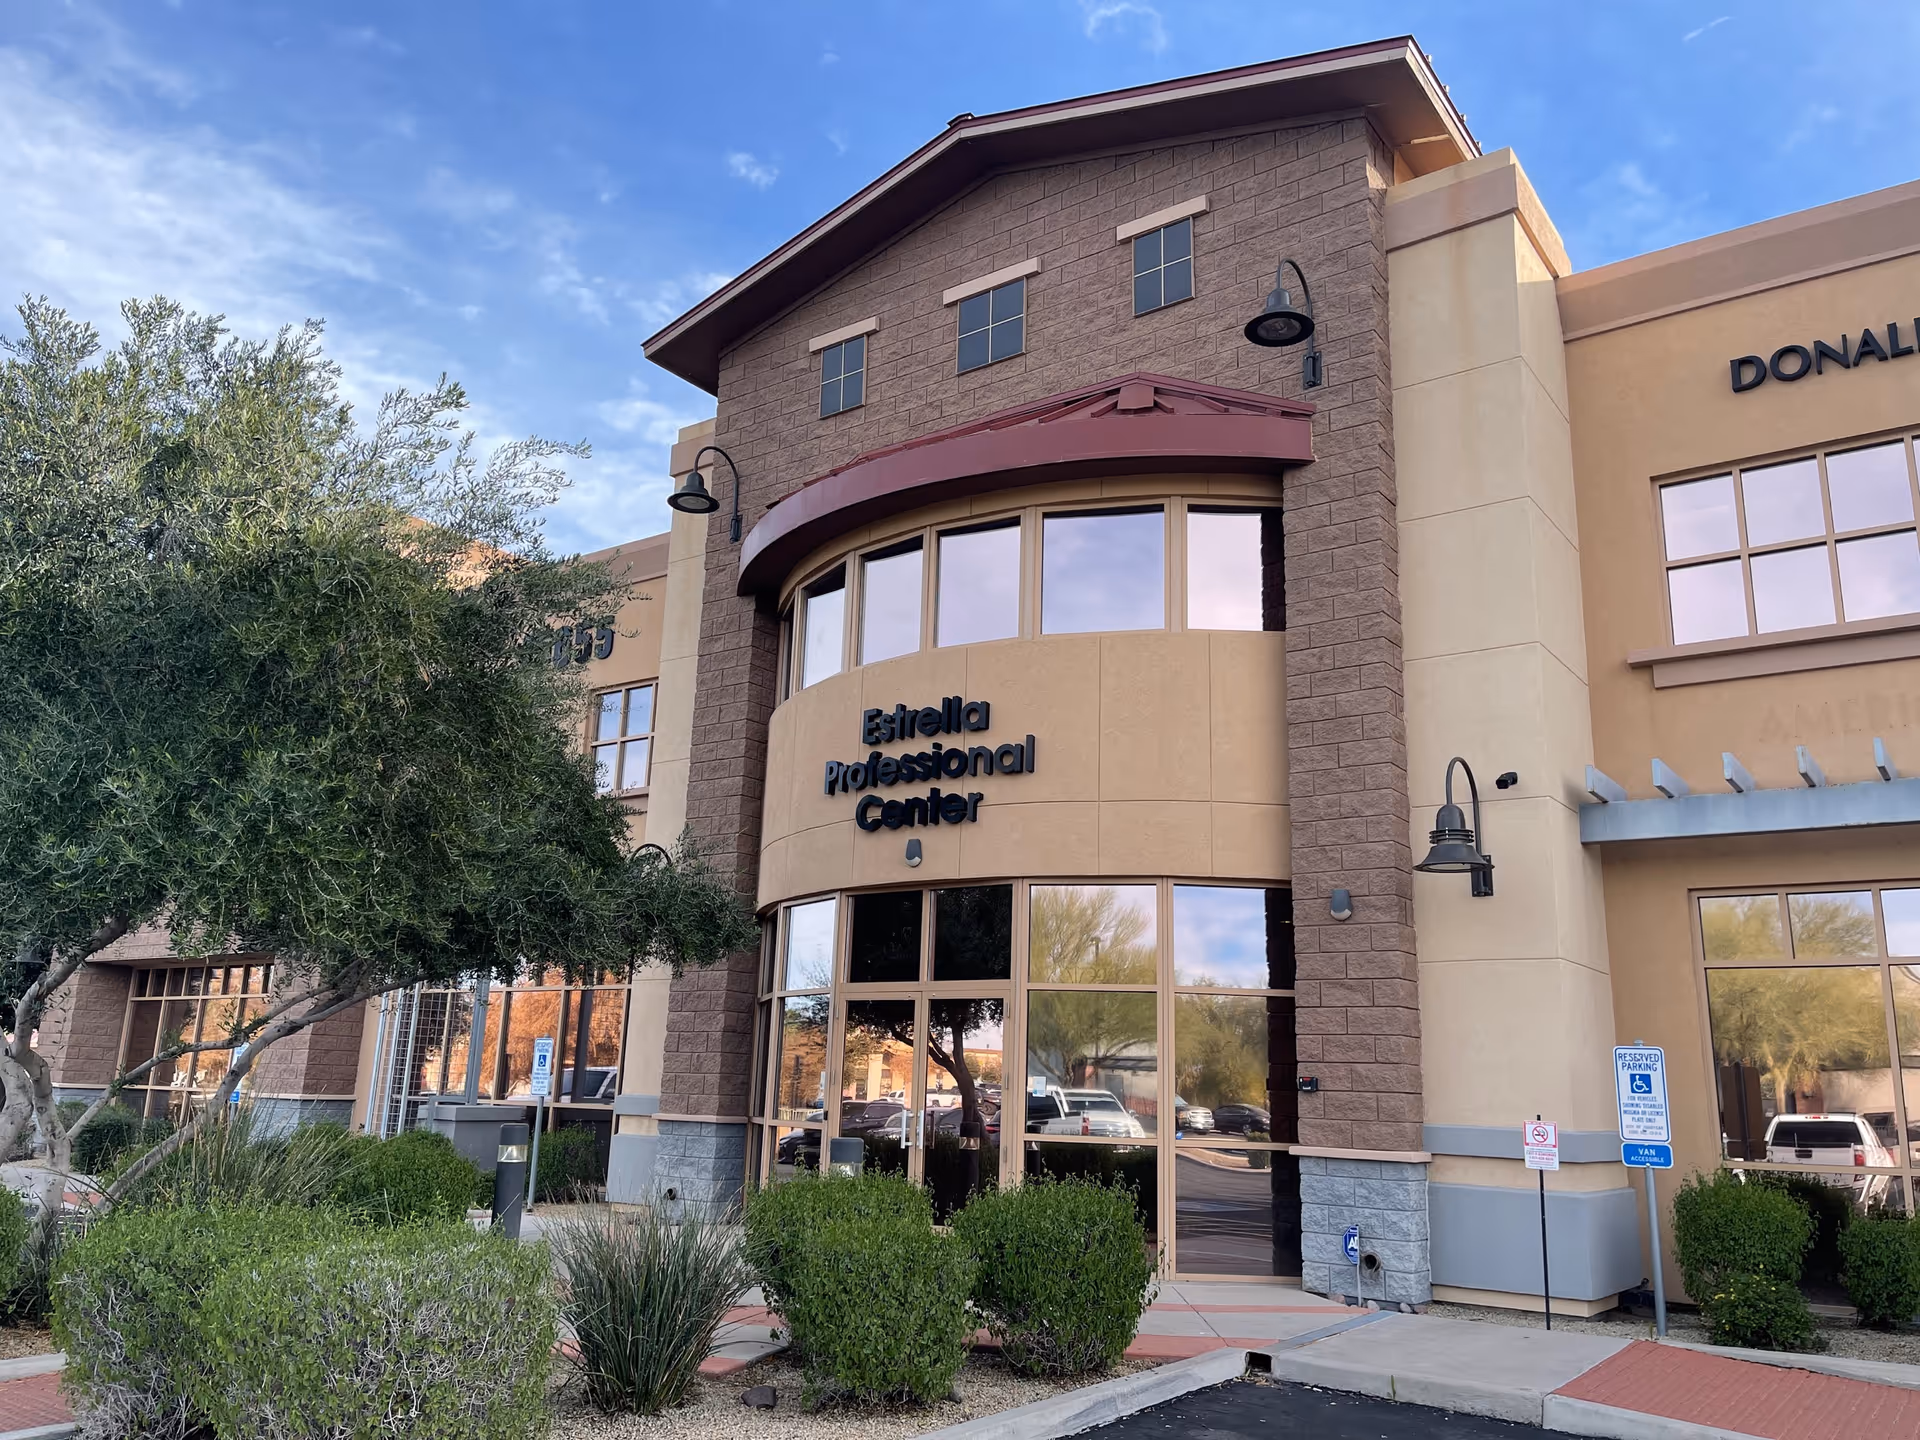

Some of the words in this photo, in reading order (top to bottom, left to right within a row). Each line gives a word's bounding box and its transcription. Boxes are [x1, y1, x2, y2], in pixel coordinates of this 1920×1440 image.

[1730, 317, 1920, 393] DONAL
[862, 696, 990, 746] Estrella
[824, 734, 1036, 796] Professional
[856, 787, 984, 832] Center
[1617, 1052, 1660, 1063] RESERVED
[1621, 1062, 1658, 1072] PARKING
[1638, 1148, 1656, 1157] VAN
